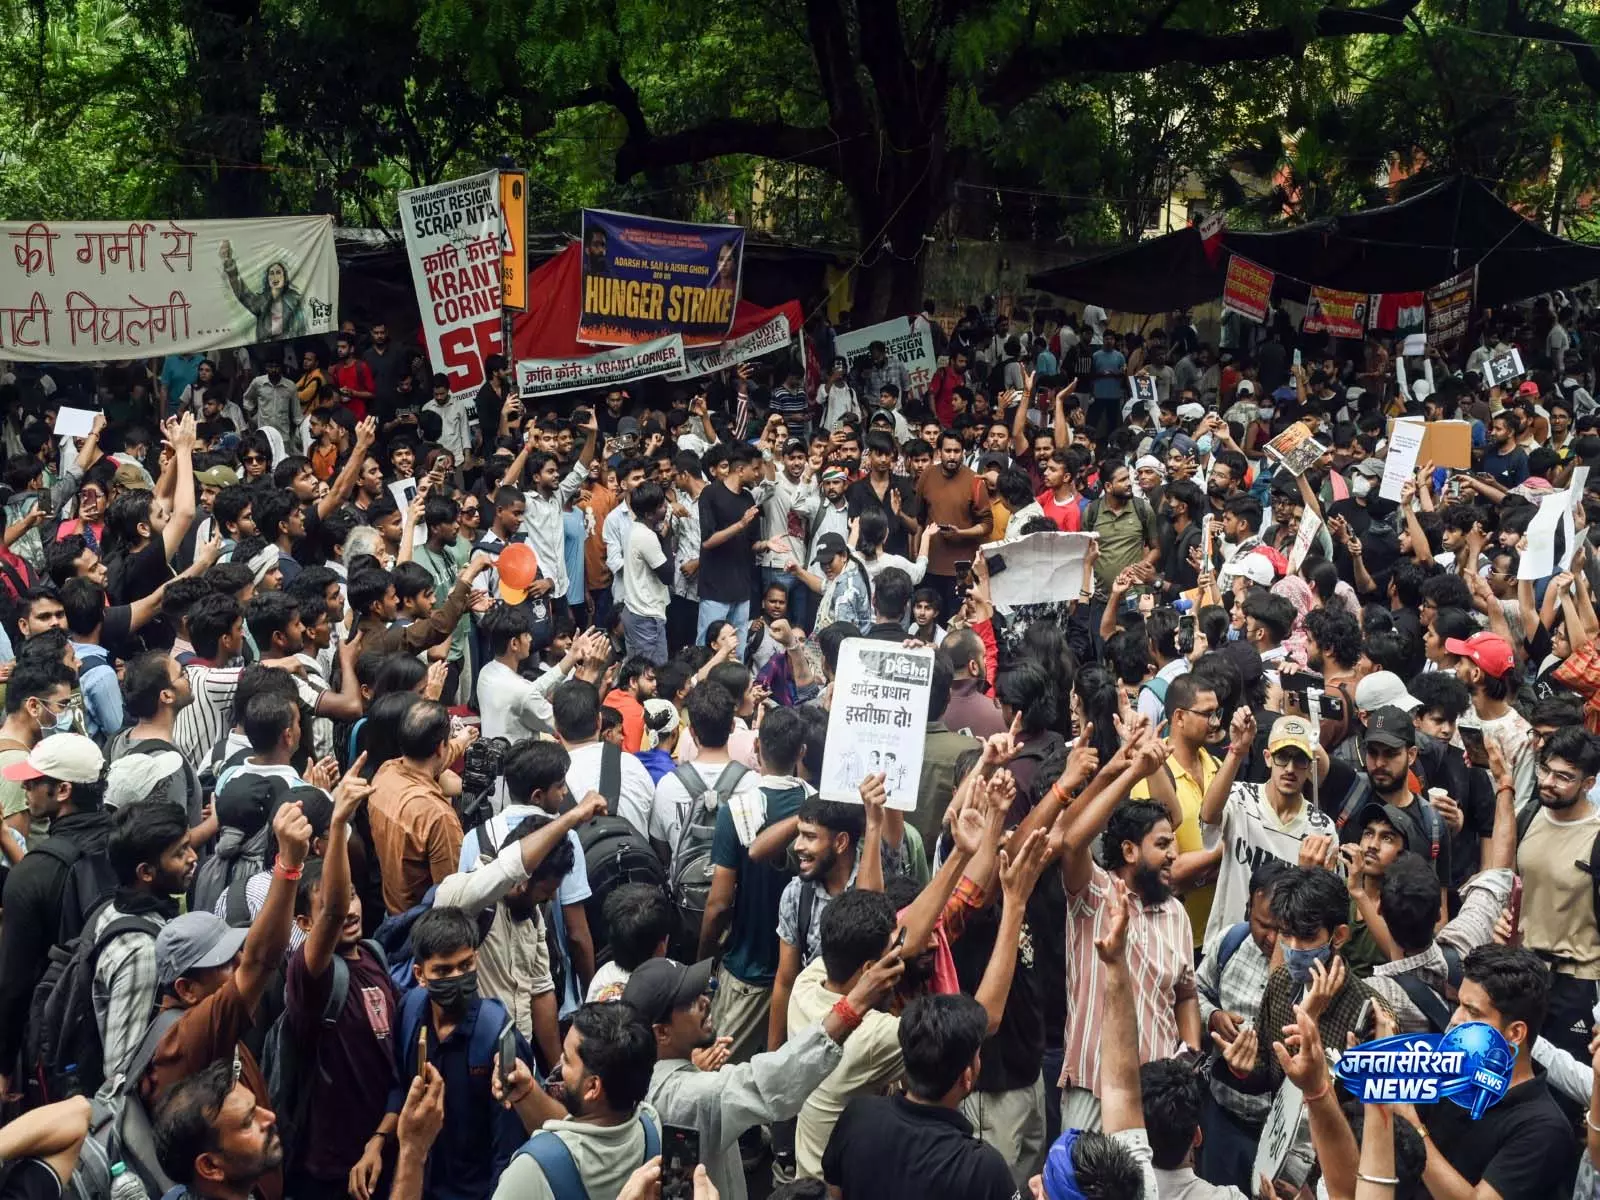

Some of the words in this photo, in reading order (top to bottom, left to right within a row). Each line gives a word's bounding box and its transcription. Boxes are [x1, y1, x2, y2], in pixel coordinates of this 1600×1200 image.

[410, 185, 458, 205] DHARMENDRA
[458, 178, 491, 195] PRADHAN
[412, 199, 446, 222] MUST
[449, 187, 493, 211] RESIGN
[415, 213, 463, 239] SCRAP
[466, 203, 499, 226] NTA
[9, 223, 60, 276] की
[75, 222, 156, 274] गर्मी
[160, 221, 197, 272] से
[421, 244, 459, 276] क्रांति
[465, 232, 500, 263] कॉर्न
[427, 259, 501, 302] KRANT
[614, 257, 641, 268] ADARSH
[689, 265, 710, 276] GHOSH
[433, 286, 502, 326] CORNE
[585, 275, 665, 321] HUNGER
[667, 286, 734, 323] STRIKE
[748, 331, 788, 353] STRUGGLE
[891, 332, 922, 345] PRADHAN
[439, 316, 503, 394] SF
[596, 356, 634, 375] KRANTI
[637, 347, 676, 367] CORNER
[897, 348, 926, 363] NTA
[881, 685, 911, 701] प्रधान
[894, 706, 912, 728] दो!
